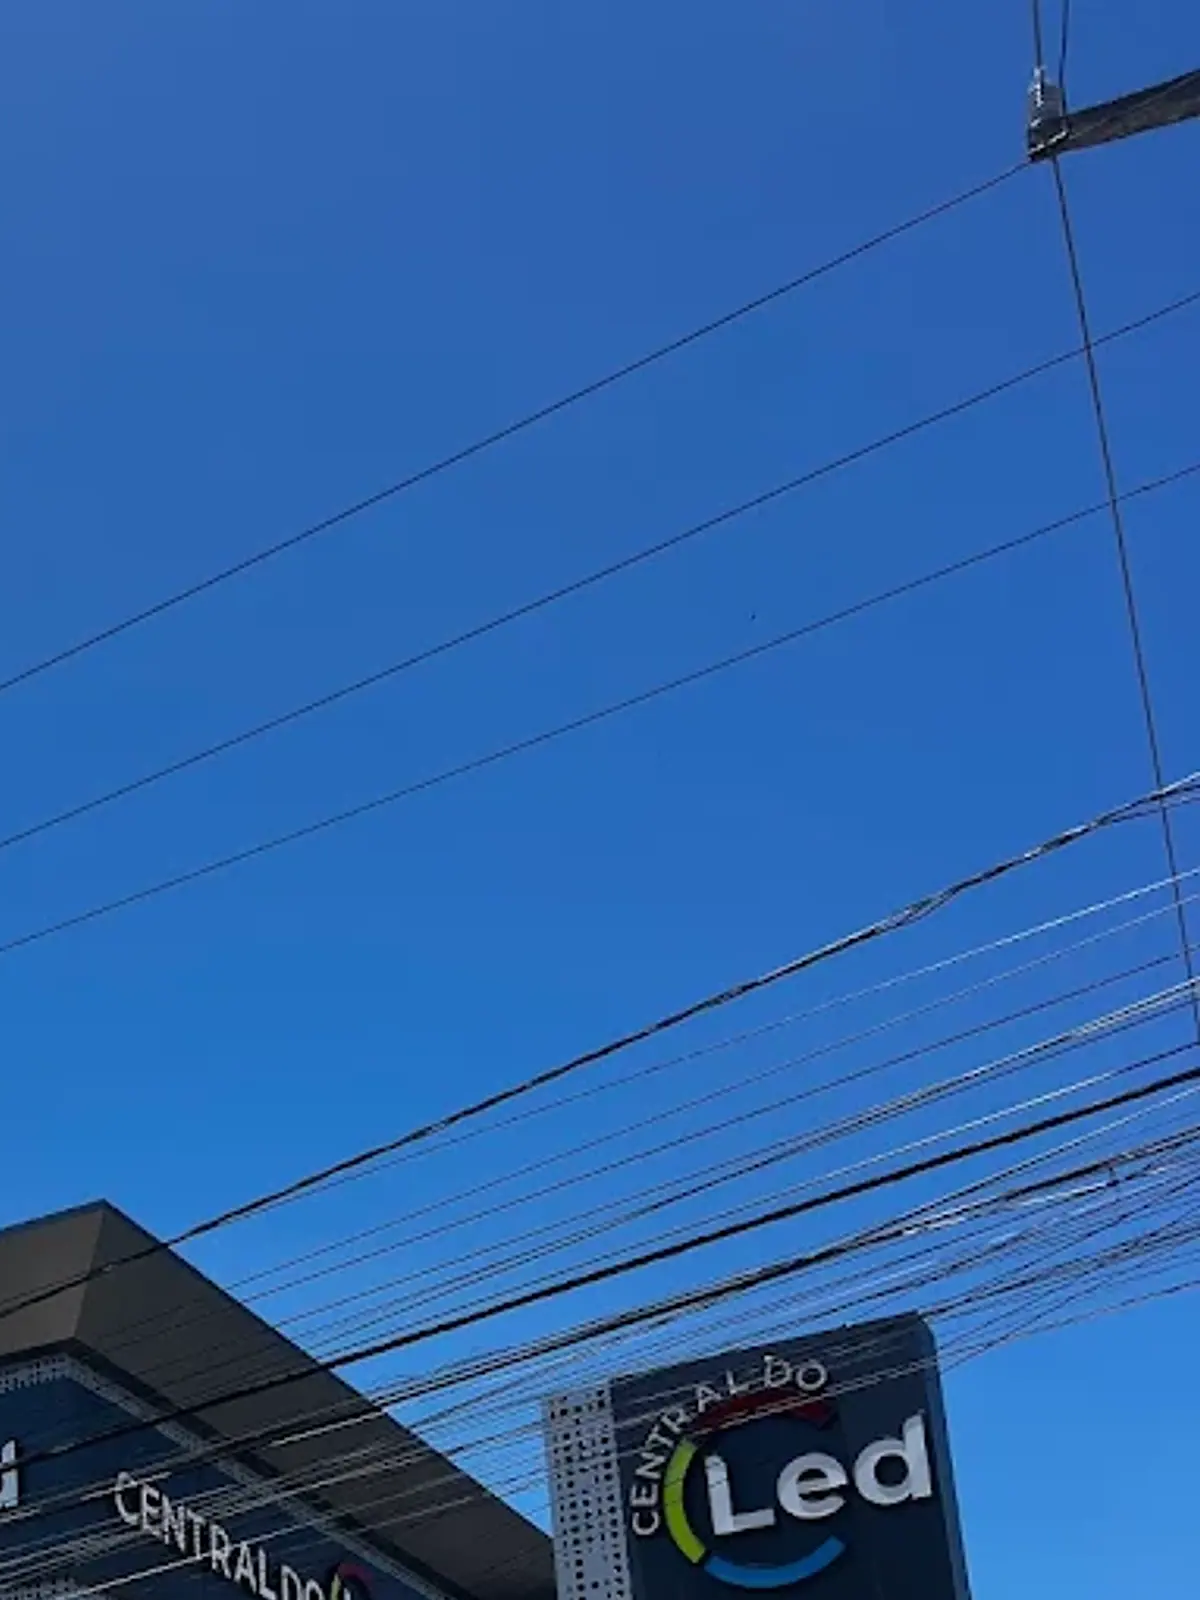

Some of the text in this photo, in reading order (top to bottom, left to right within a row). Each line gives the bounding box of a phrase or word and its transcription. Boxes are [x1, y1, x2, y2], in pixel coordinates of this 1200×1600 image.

[630, 1354, 829, 1537] CENTRAL DO
[704, 1408, 933, 1537] Led
